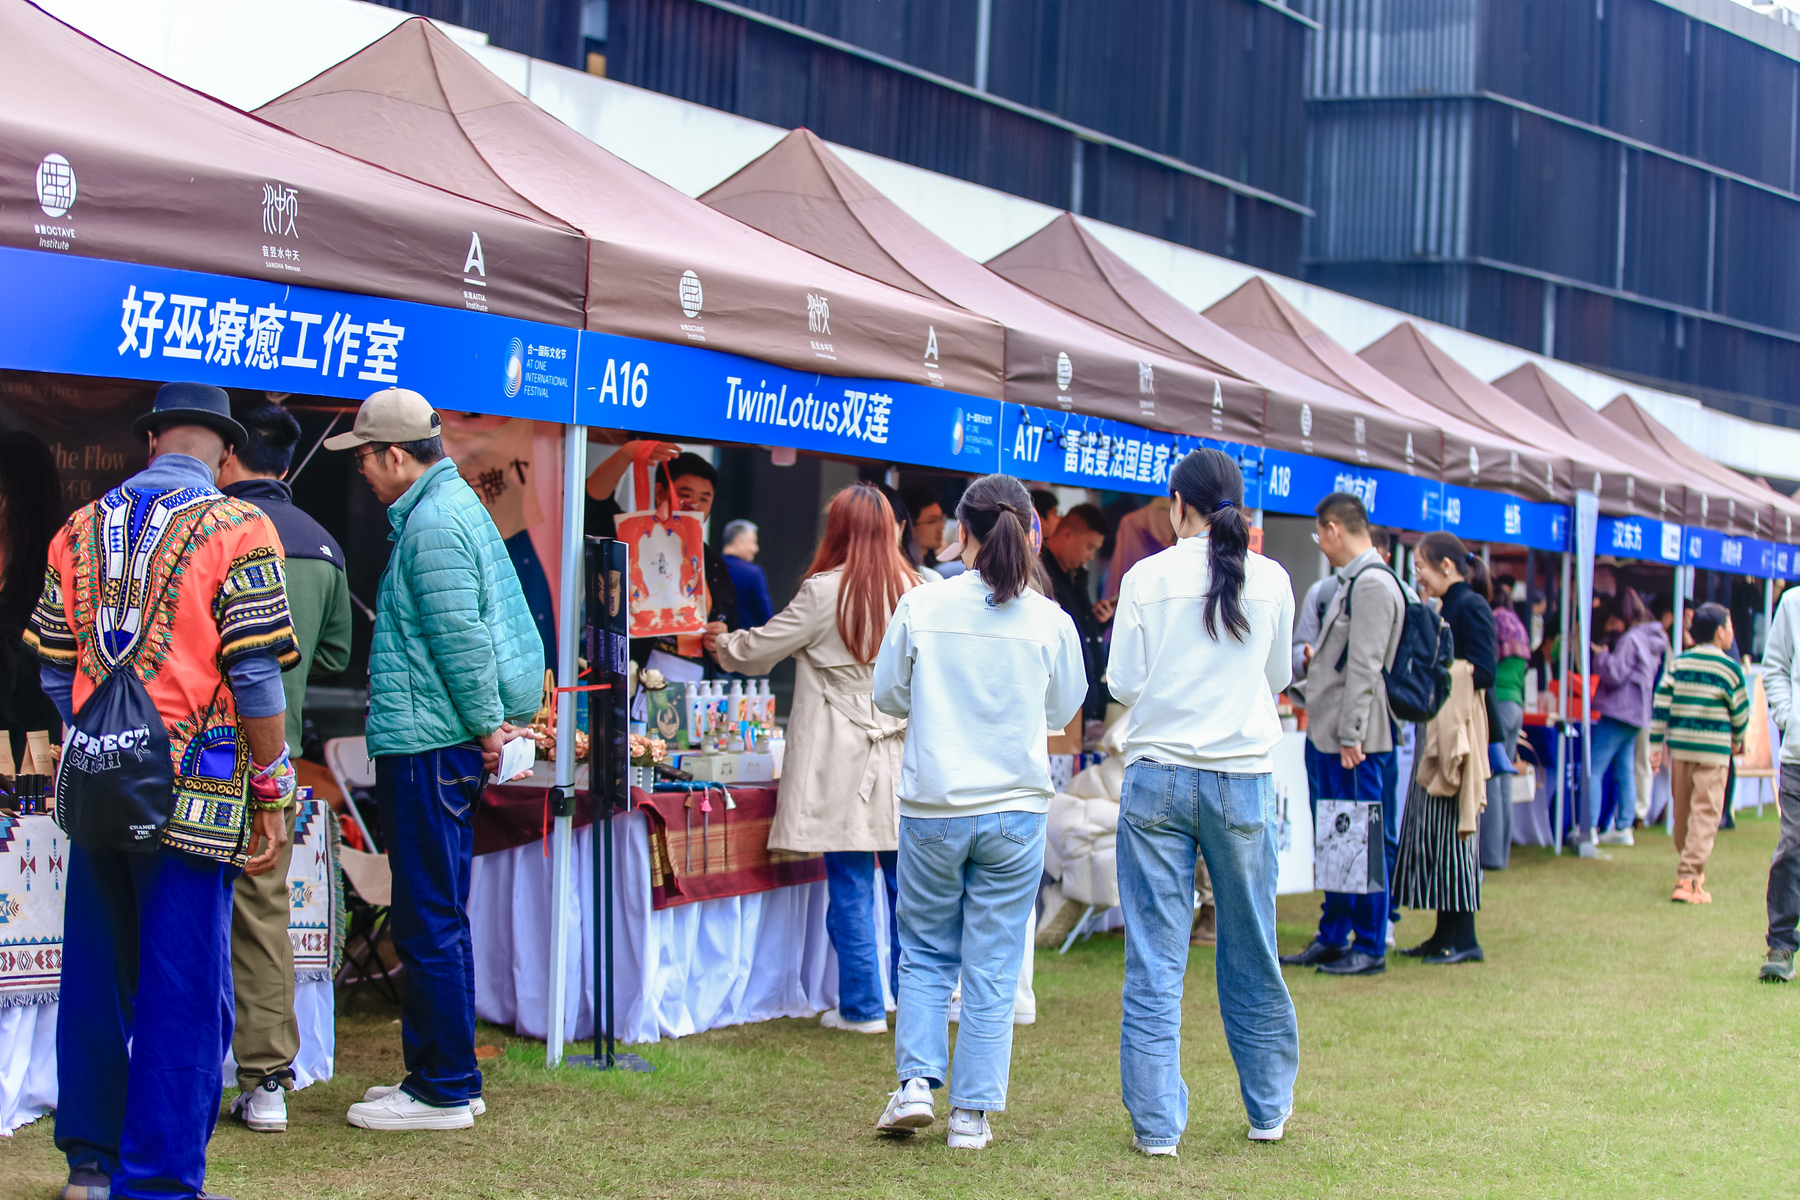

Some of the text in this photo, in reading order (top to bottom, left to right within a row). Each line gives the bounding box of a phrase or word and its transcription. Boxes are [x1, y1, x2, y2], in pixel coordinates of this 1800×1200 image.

[39, 237, 70, 250] Institute
[465, 300, 489, 313] Institute
[117, 284, 405, 384] 好巫療癒工作室
[527, 343, 567, 360] 合一国际文化节
[525, 358, 547, 372] AT ONE
[525, 372, 569, 388] INTERNATIONAL
[599, 358, 649, 409] A16
[523, 385, 550, 399] FESTIVAL
[1013, 423, 1044, 463] A17
[84, 444, 128, 472] Flow
[1269, 464, 1291, 498] A18
